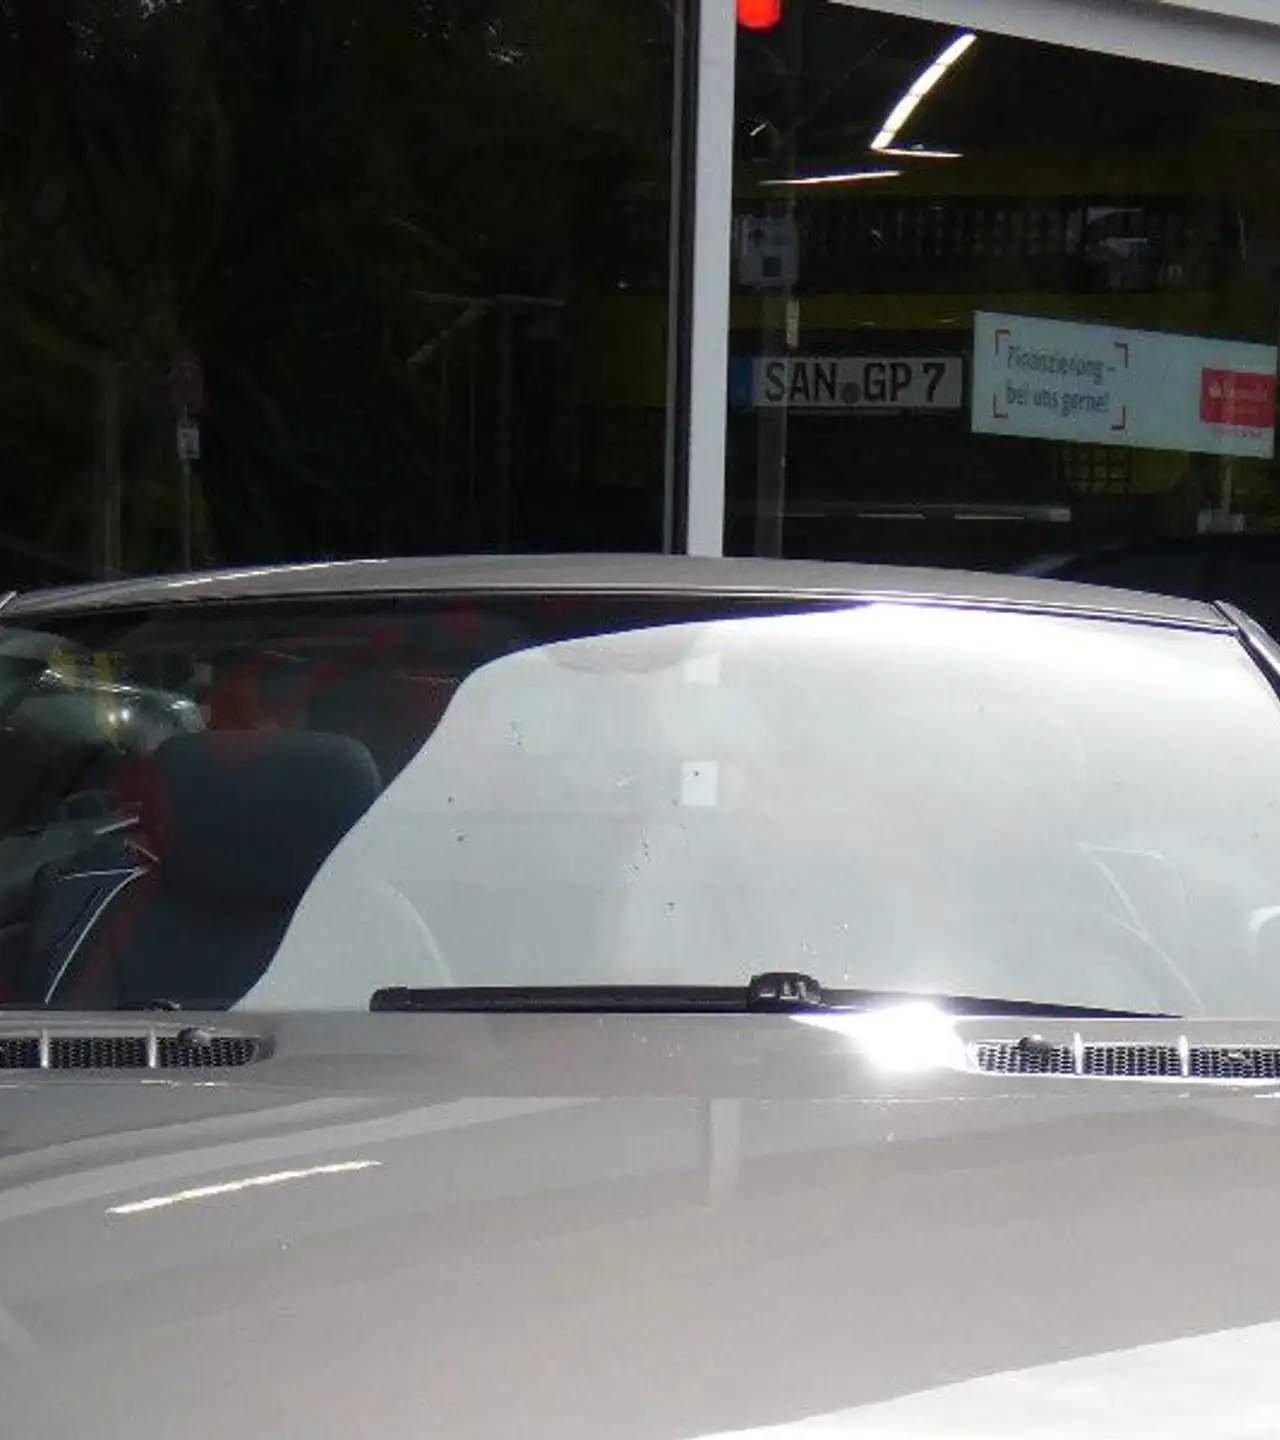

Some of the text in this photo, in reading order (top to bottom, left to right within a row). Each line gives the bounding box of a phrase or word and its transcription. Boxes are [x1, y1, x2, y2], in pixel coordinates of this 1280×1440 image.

[765, 362, 946, 402] SAN GP 7
